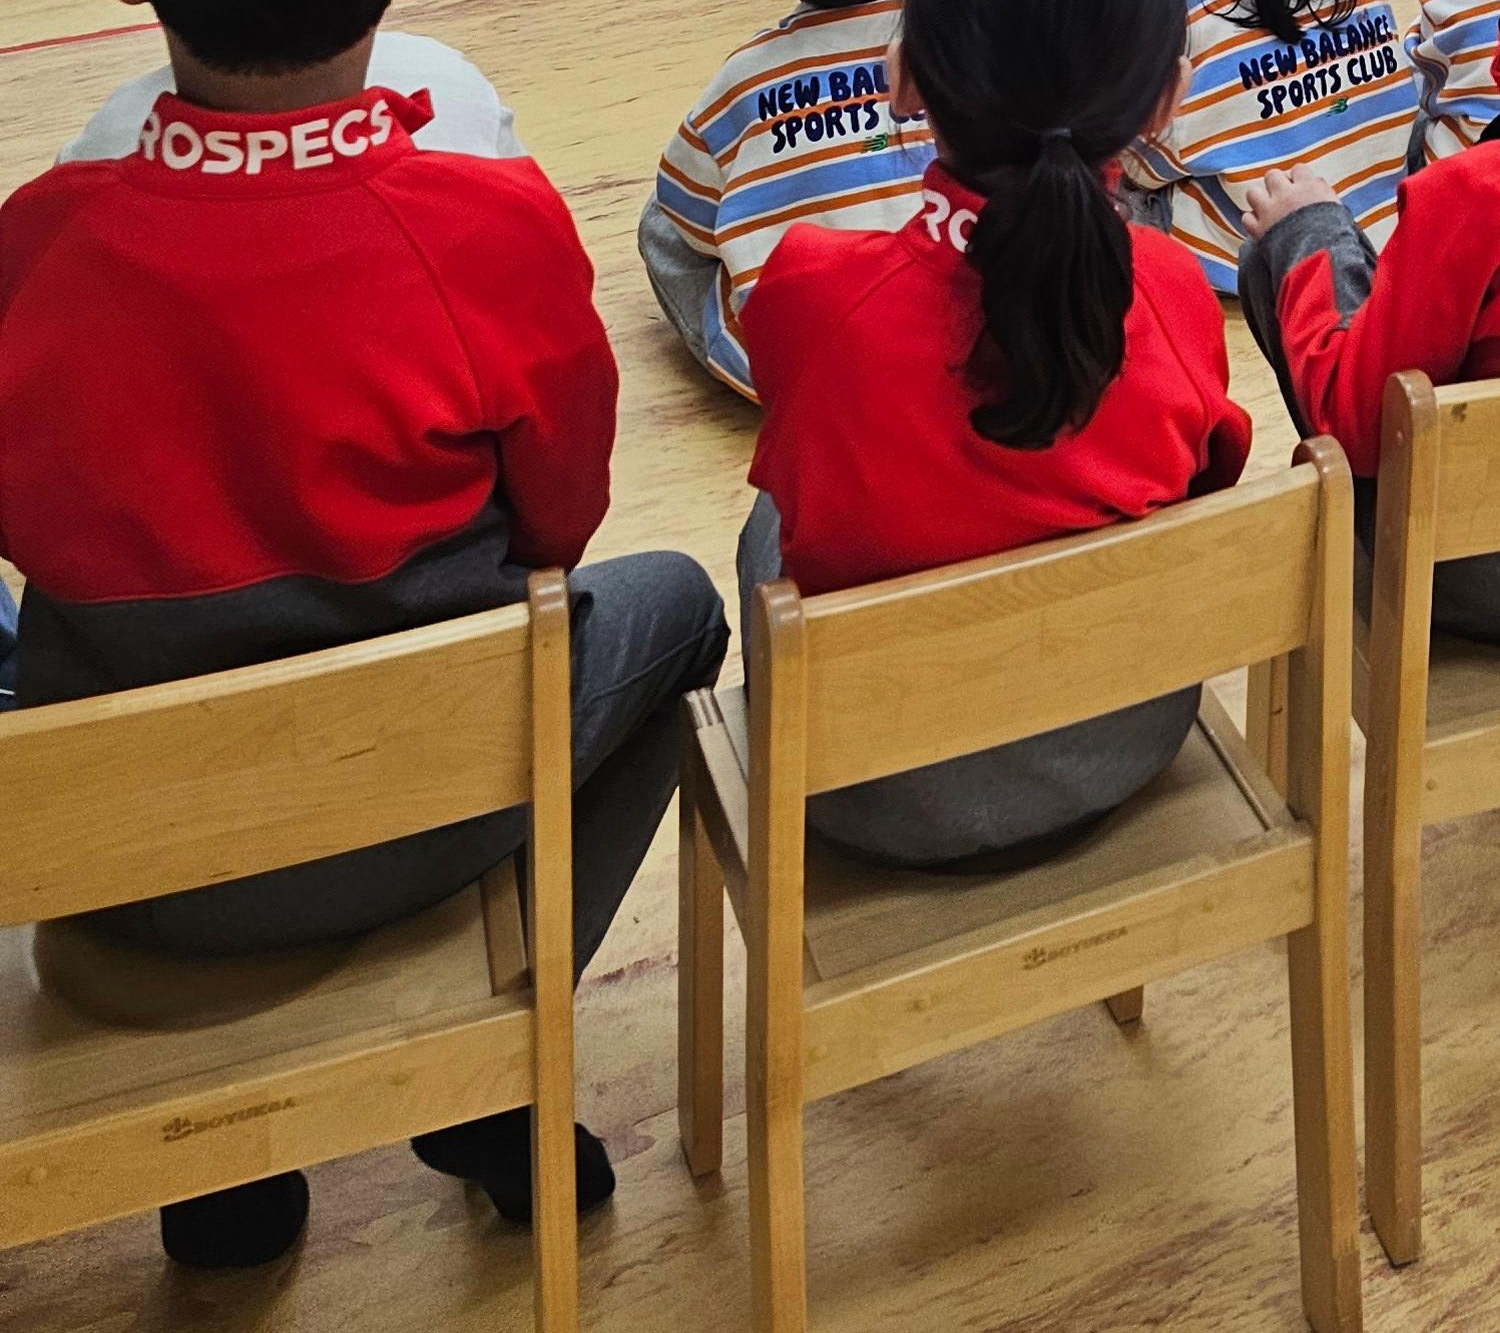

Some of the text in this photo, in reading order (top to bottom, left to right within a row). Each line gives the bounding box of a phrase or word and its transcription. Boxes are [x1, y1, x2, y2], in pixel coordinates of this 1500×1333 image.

[1239, 14, 1394, 90] NEW BALANCE
[1257, 45, 1398, 119] SPORTS CLUB
[758, 64, 890, 122] NEW BAL
[771, 99, 880, 154] SPORTS
